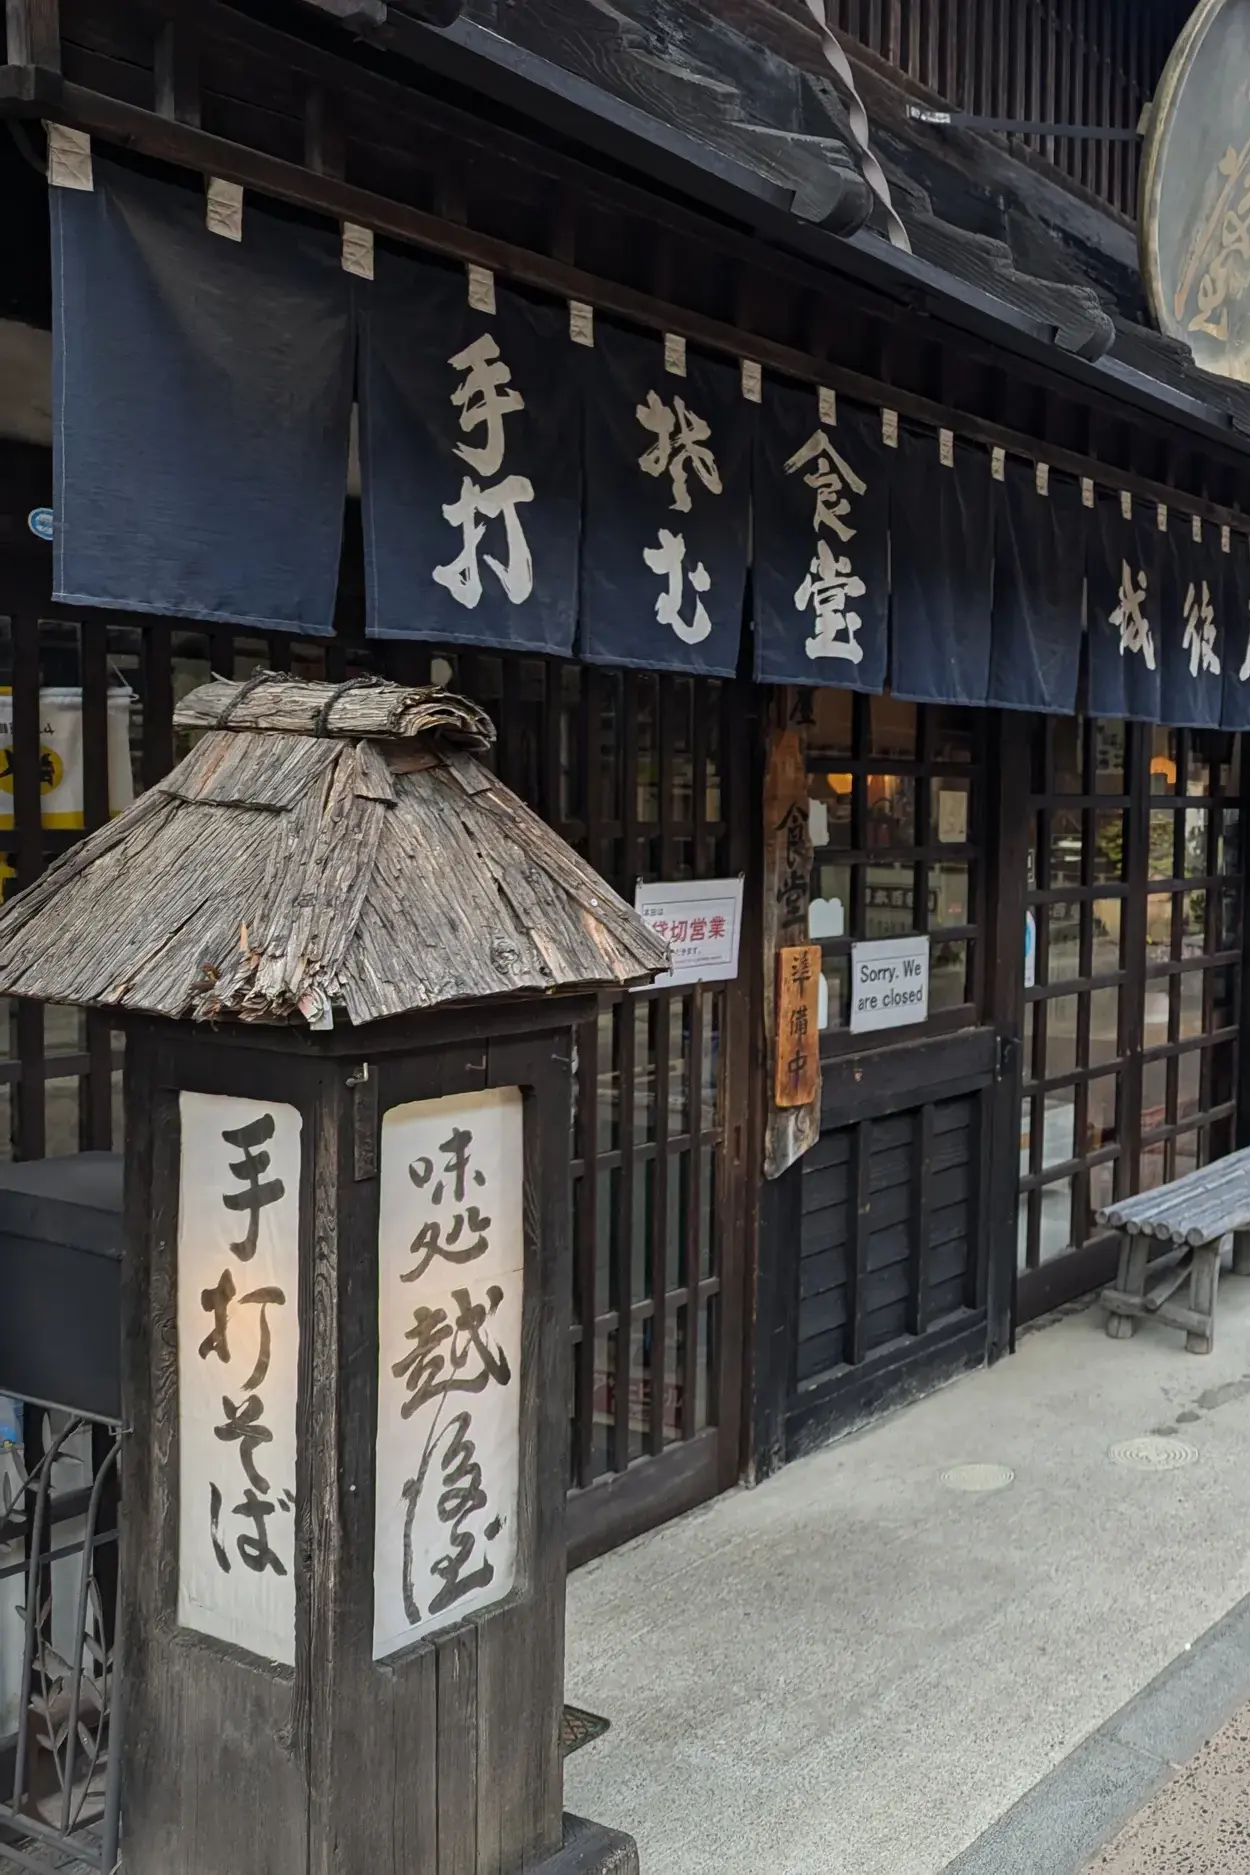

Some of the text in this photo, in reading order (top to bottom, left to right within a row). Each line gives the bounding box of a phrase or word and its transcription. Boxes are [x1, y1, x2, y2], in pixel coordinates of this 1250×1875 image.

[433, 333, 534, 608] 手打
[784, 429, 867, 664] 食堂
[788, 951, 811, 1088] 準備中
[858, 984, 923, 1011] are closed
[903, 959, 922, 977] We
[199, 1112, 296, 1577] 手打そば
